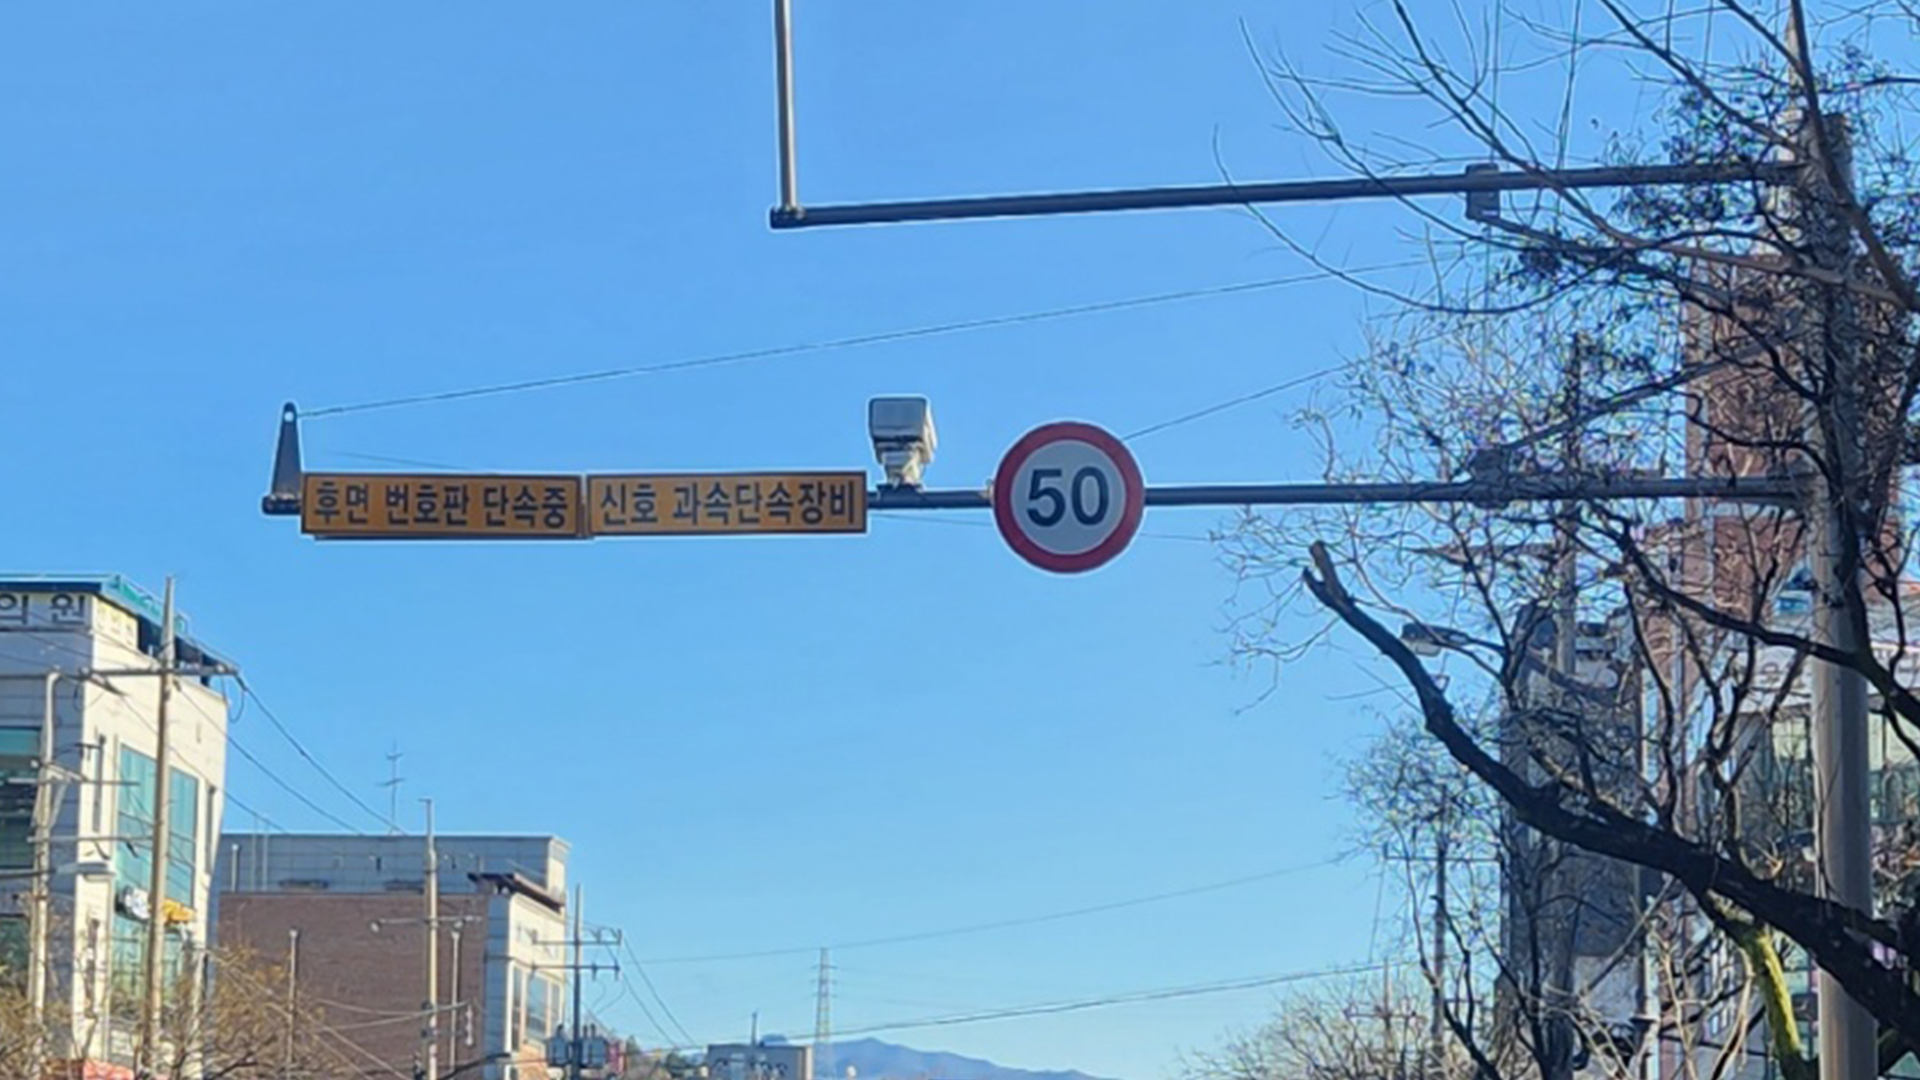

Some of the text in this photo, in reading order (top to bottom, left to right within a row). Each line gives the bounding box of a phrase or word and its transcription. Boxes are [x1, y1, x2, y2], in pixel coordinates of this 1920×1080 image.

[314, 480, 569, 529] 후면 번호판 단속중
[601, 480, 856, 526] 신호 과속단속장비
[1026, 465, 1110, 528] 50
